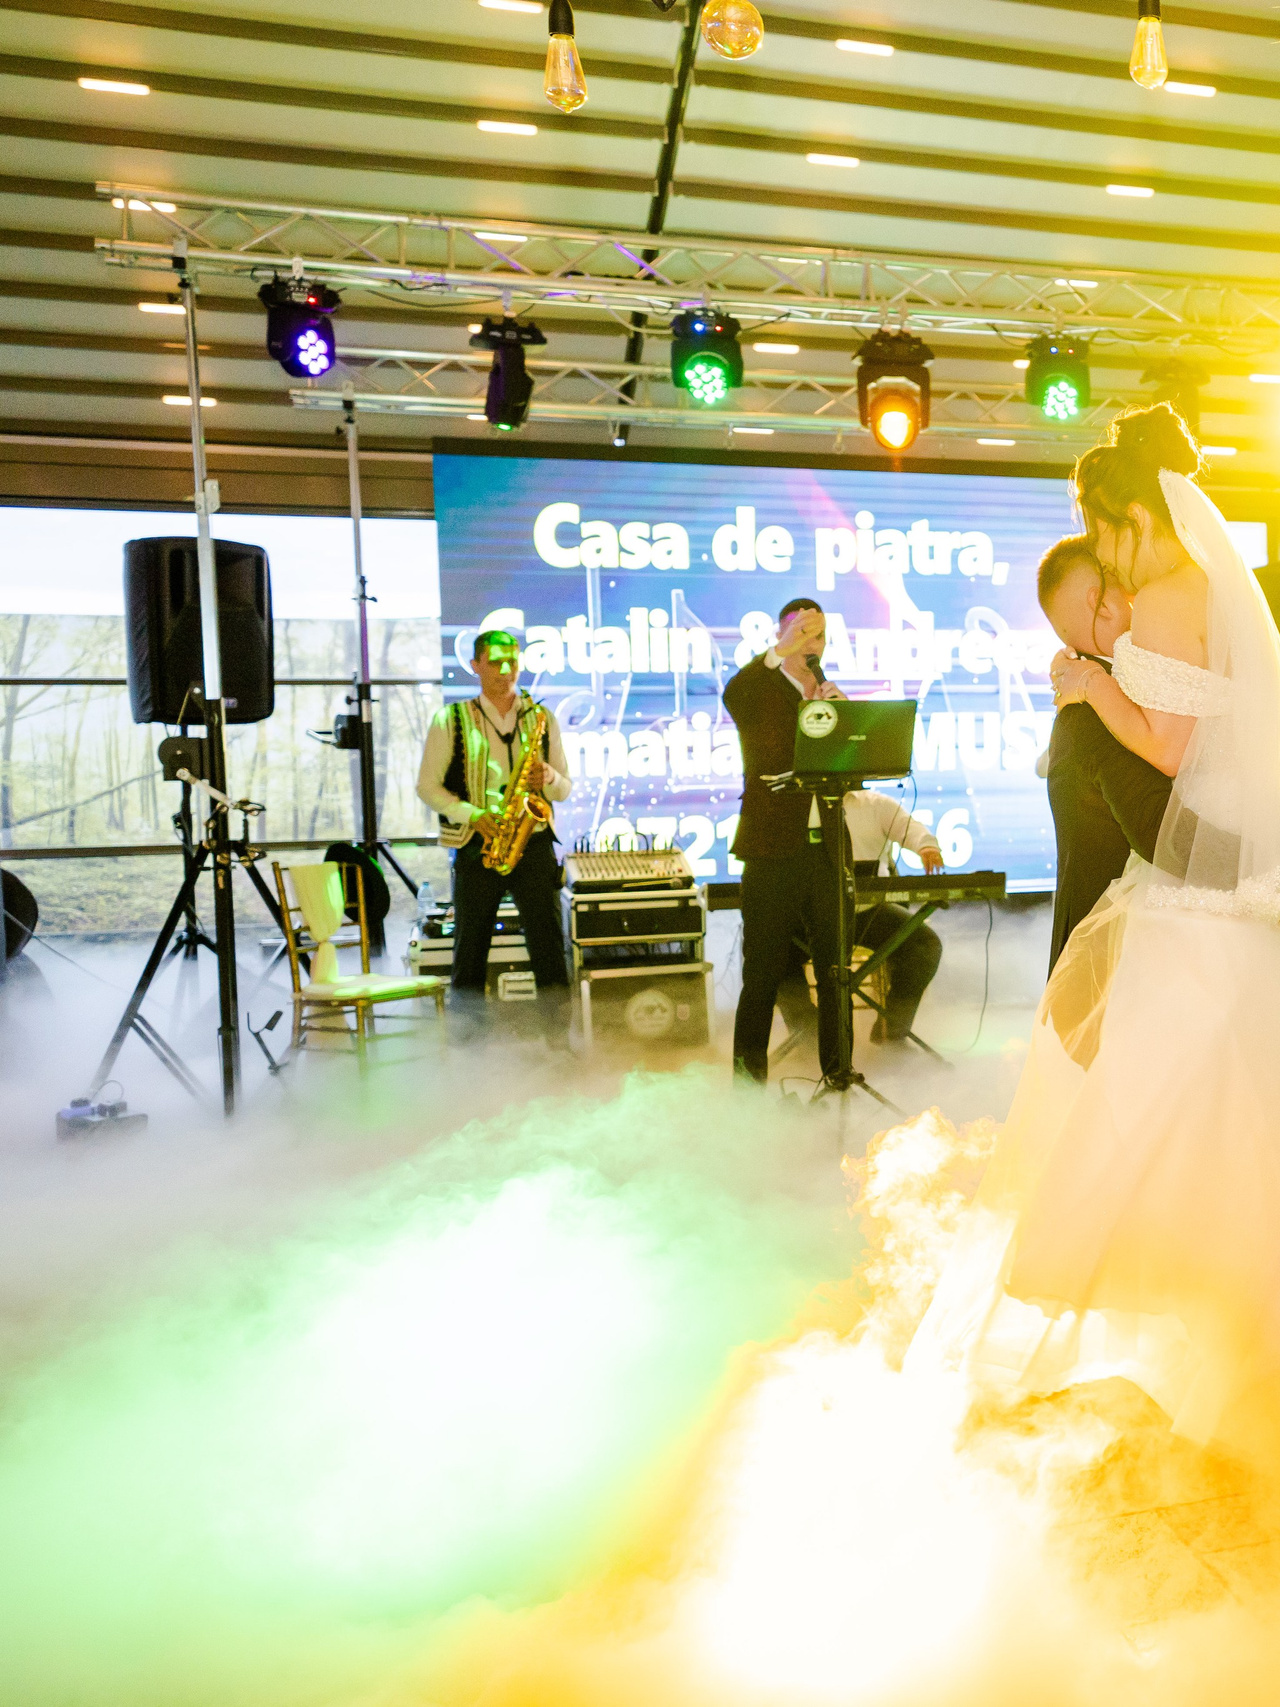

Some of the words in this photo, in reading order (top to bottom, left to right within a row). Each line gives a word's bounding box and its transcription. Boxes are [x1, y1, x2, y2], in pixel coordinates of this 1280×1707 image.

[533, 502, 690, 570] Casa
[711, 506, 794, 572] de
[815, 510, 1009, 591] piatra,
[734, 611, 779, 668] &
